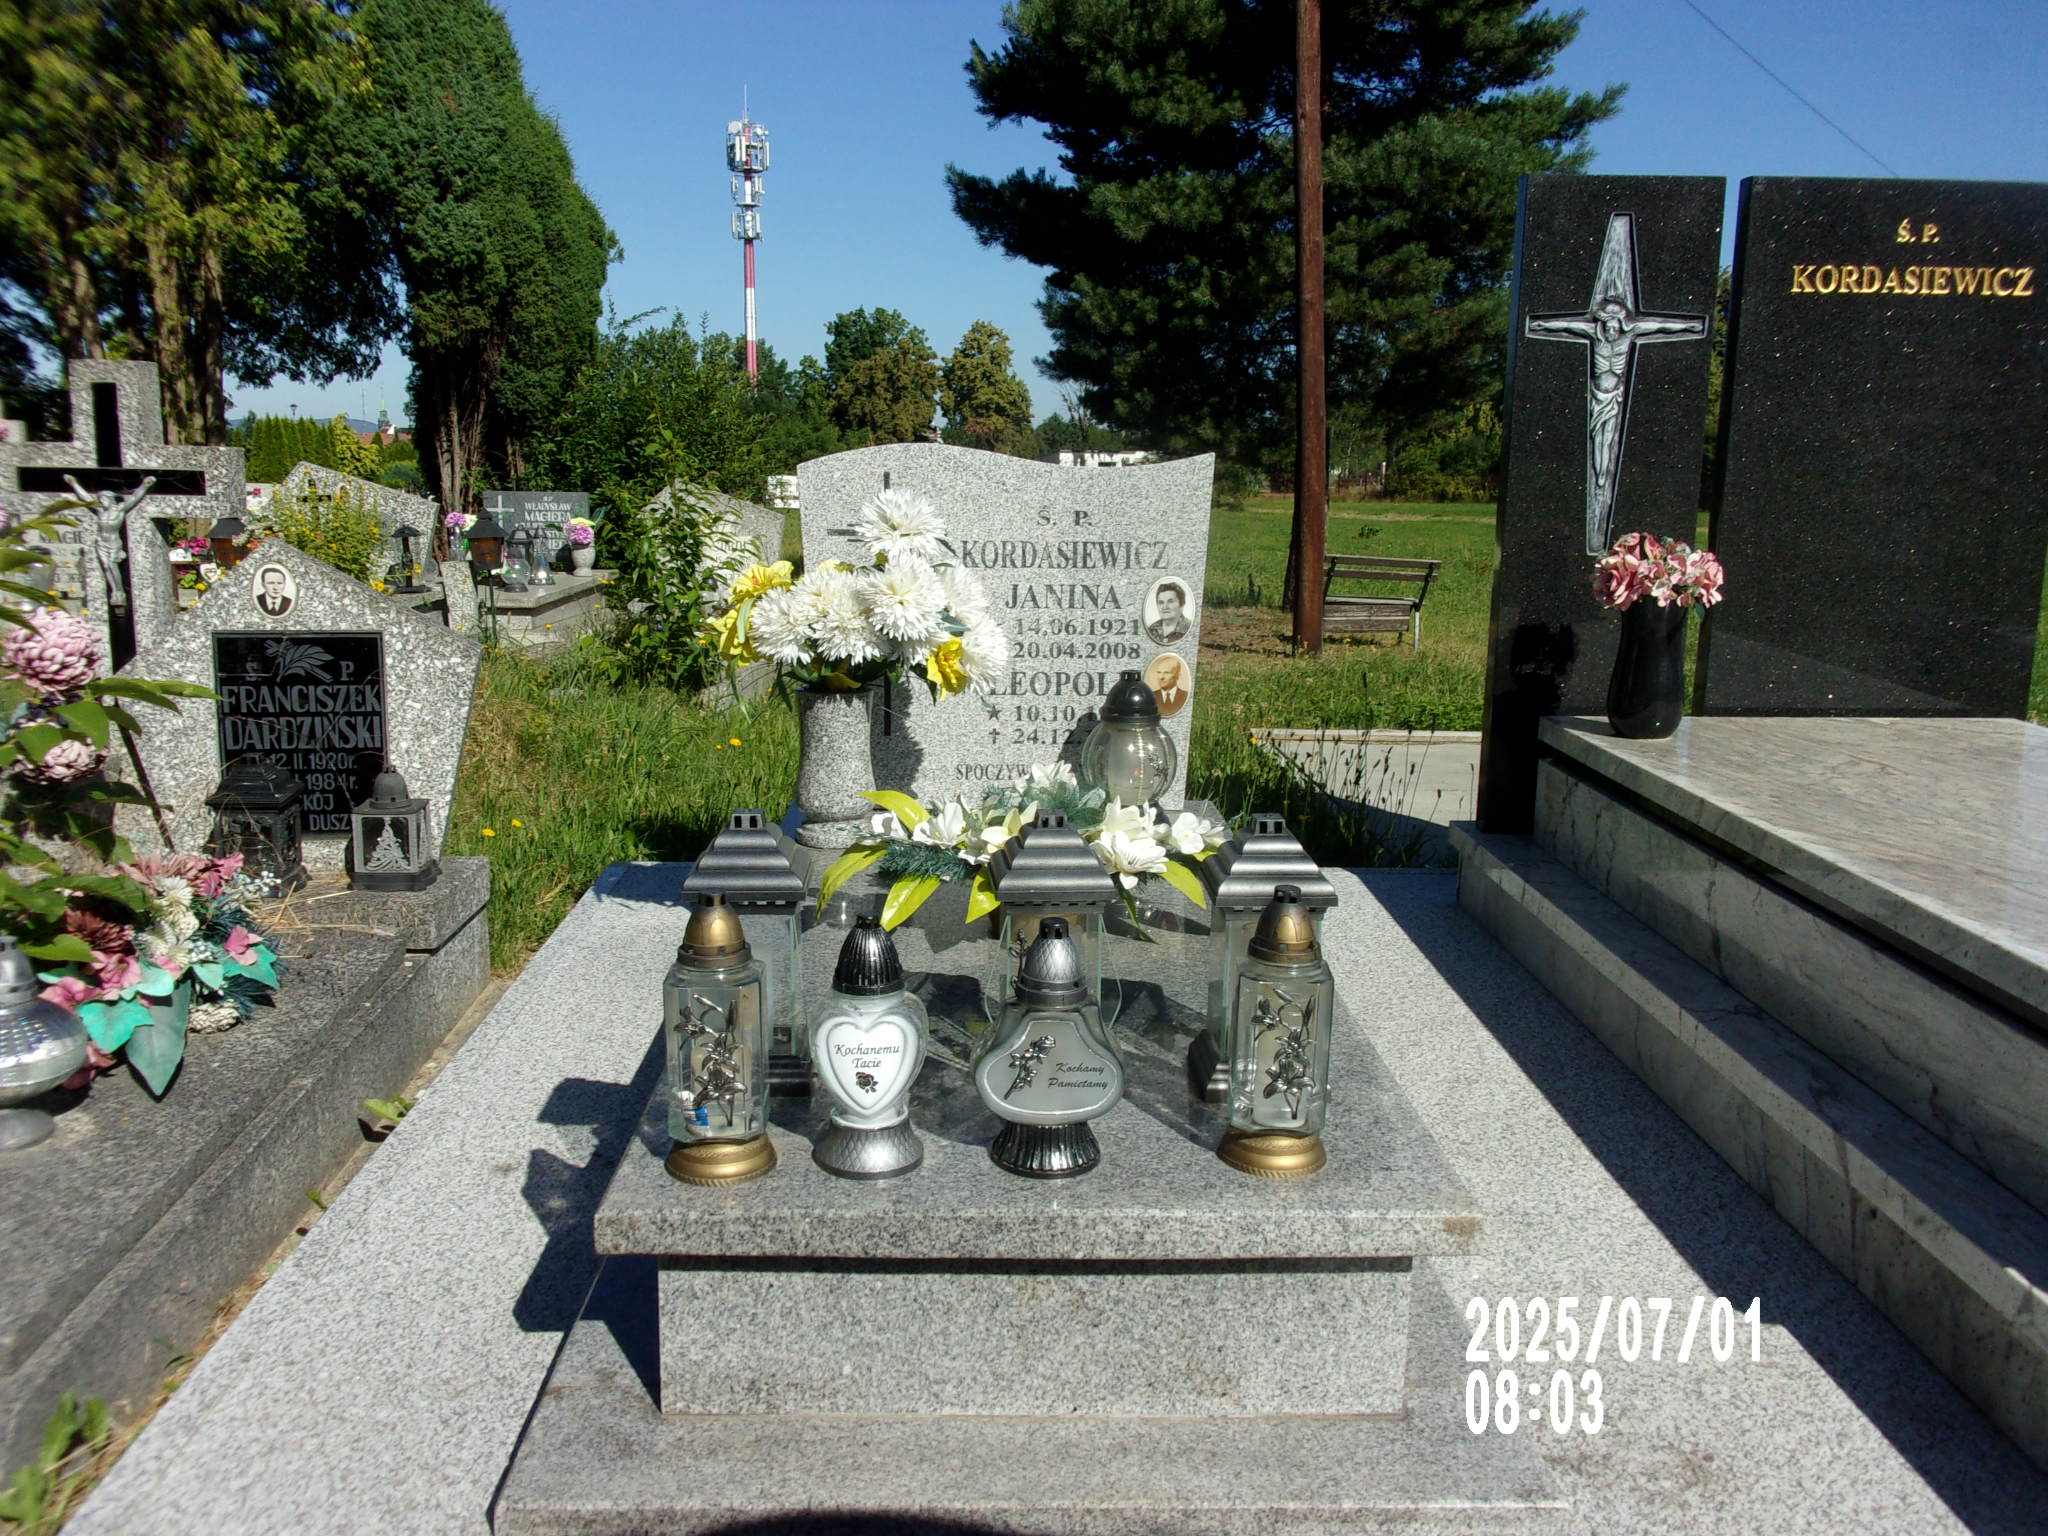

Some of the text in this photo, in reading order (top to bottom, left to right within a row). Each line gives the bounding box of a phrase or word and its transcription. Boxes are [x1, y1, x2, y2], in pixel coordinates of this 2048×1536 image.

[1921, 223, 1941, 243] P.
[1790, 264, 2035, 297] KORDASIEWICZ
[1073, 510, 1093, 526] P.
[960, 540, 1169, 569] KORDASIEWICZ
[1005, 584, 1122, 609] JANINA
[1014, 618, 1141, 636] 14.06.1921
[1012, 642, 1141, 659] 20.04.2008
[221, 685, 381, 713] FRANCISZEK
[310, 814, 351, 831] DUSZ
[834, 1043, 901, 1057] Kochanemu
[852, 1057, 882, 1069] Tacie
[1055, 1062, 1105, 1076] Kochamy
